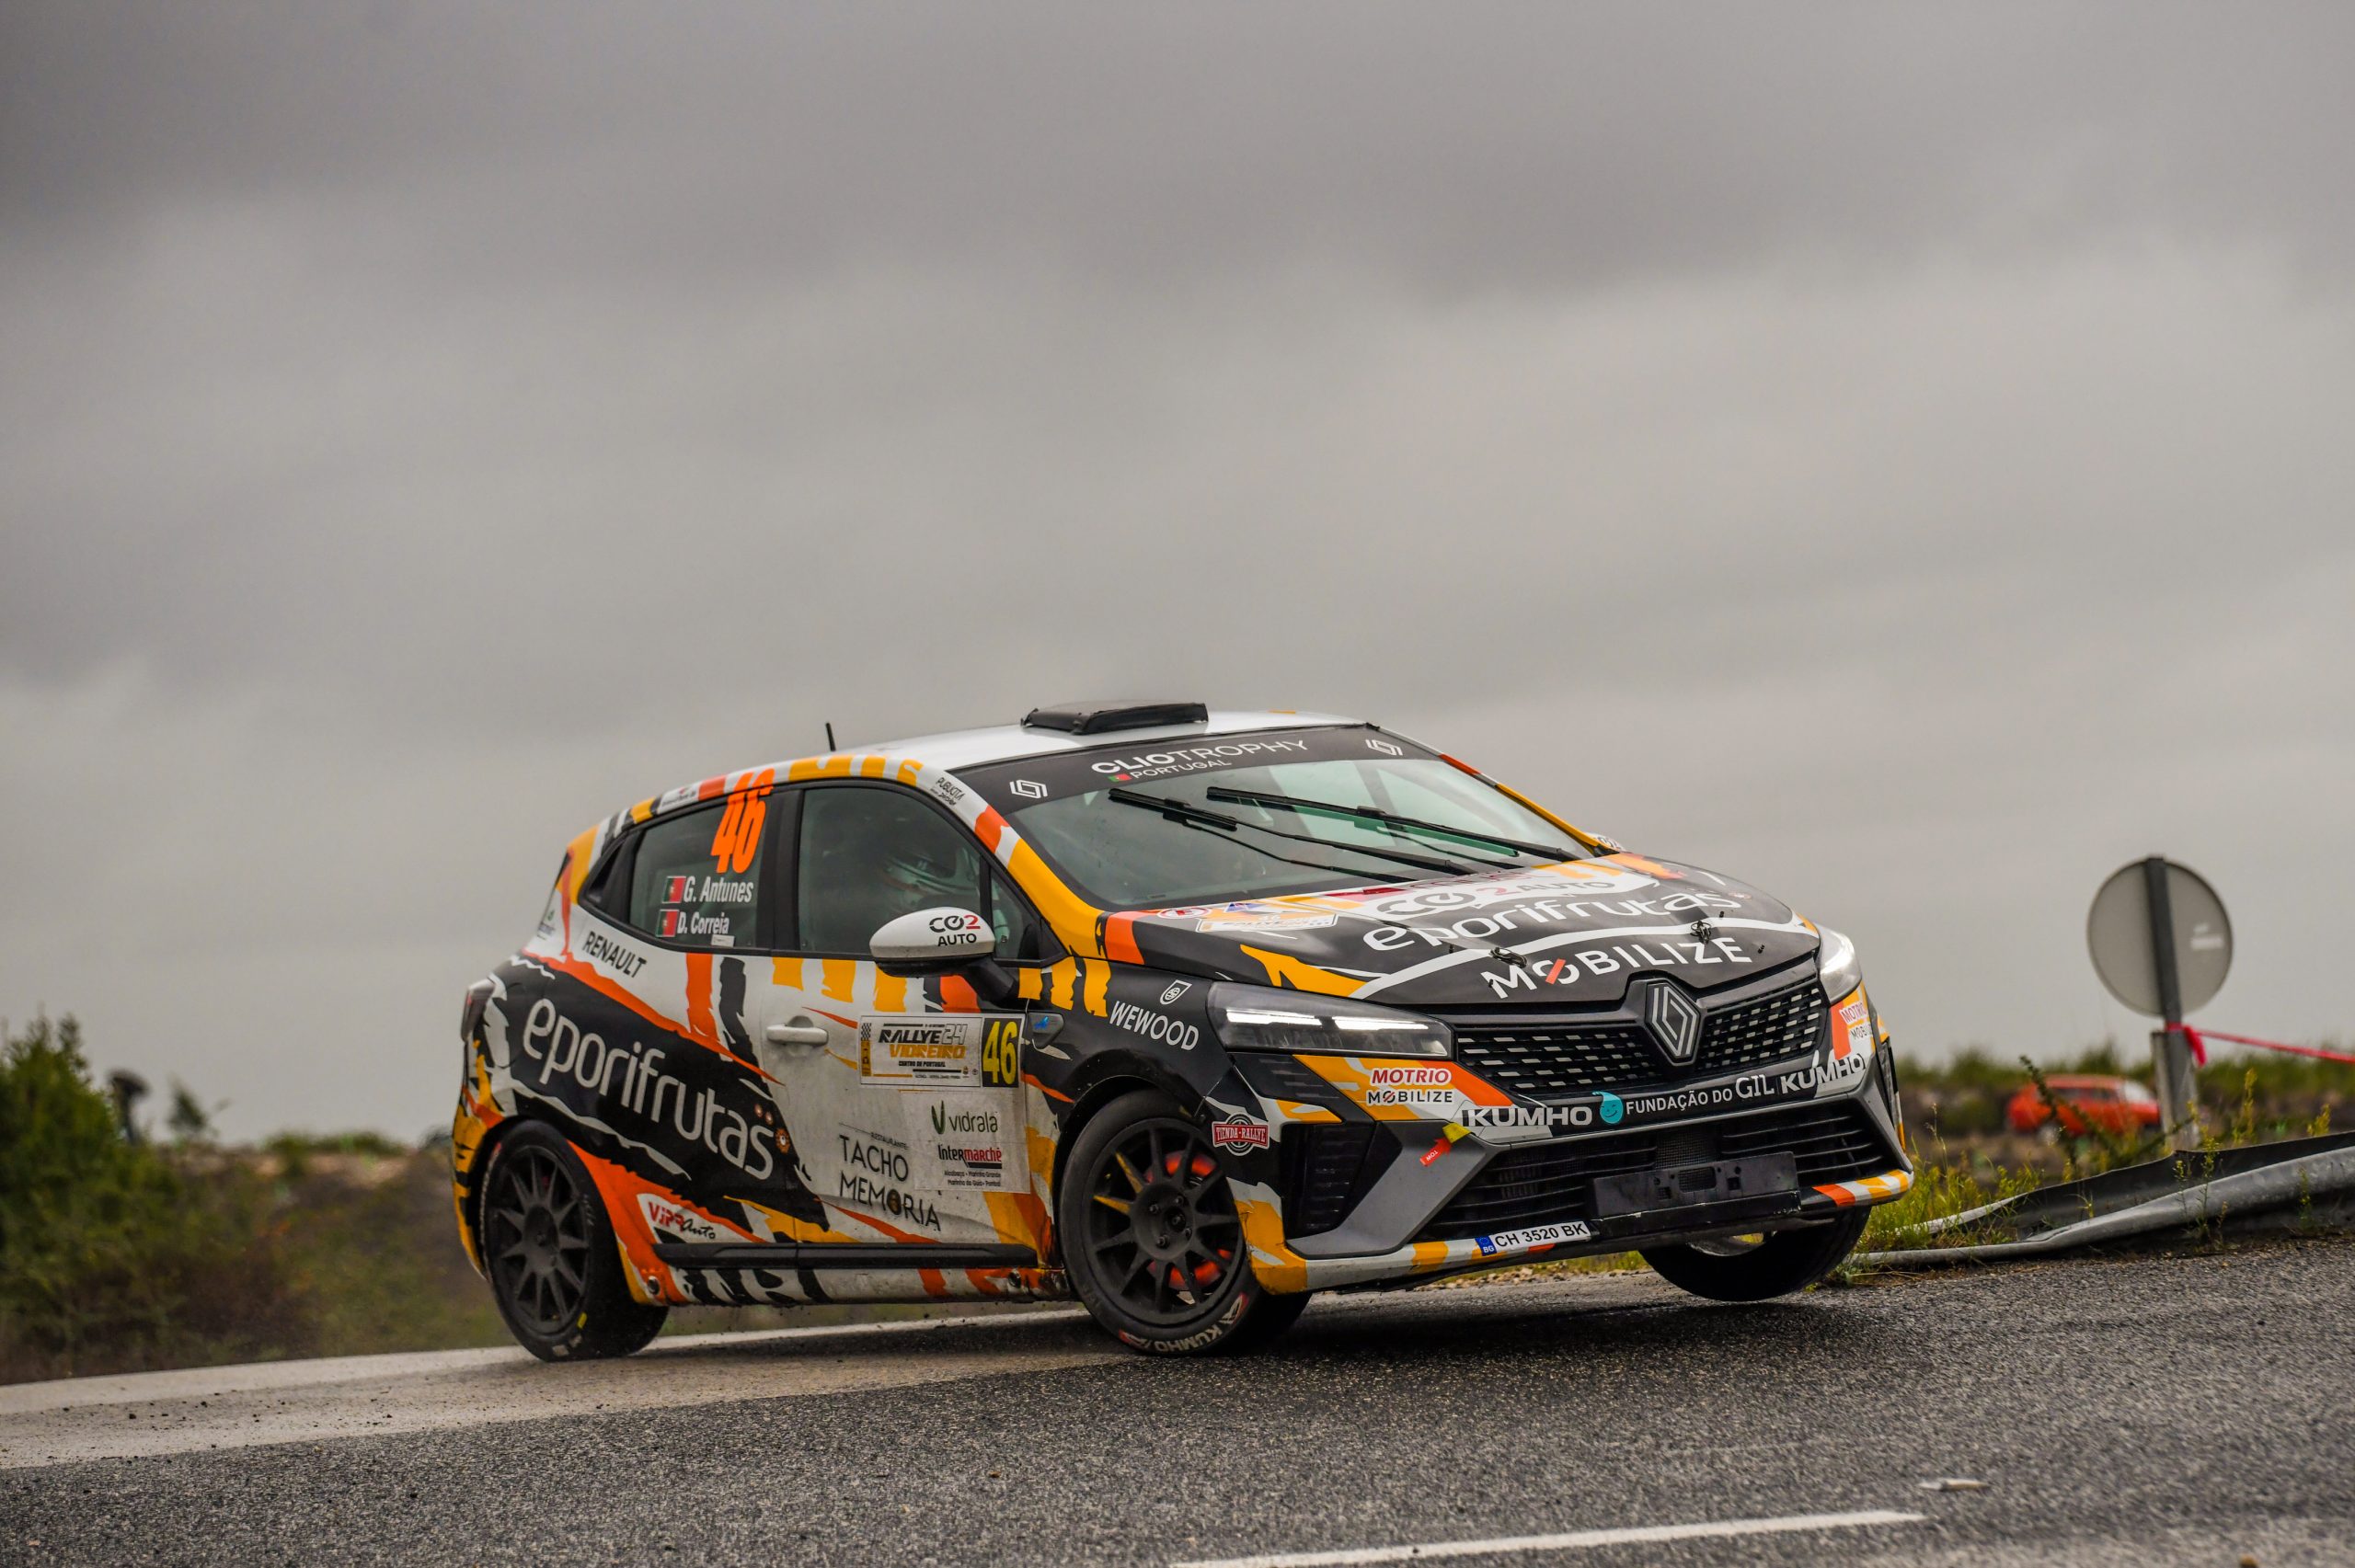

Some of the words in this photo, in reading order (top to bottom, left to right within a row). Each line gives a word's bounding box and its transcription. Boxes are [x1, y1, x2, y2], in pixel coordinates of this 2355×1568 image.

[1130, 759, 1233, 779] PORTUGAL
[710, 767, 775, 874] 46
[684, 876, 696, 903] G.
[699, 876, 753, 903] Antunes
[1515, 881, 1615, 892] AUTO
[677, 910, 687, 934] D.
[690, 911, 729, 934] Correia
[1363, 892, 1741, 951] eporifrutas
[938, 933, 977, 947] AUTO
[581, 931, 648, 979] RENAULT
[879, 1029, 942, 1044] RALLYE
[941, 1024, 968, 1045] 24
[1109, 1000, 1200, 1051] WEWOOD
[982, 1021, 1018, 1085] 46
[1372, 1069, 1450, 1085] MOTRIO
[1780, 1053, 1867, 1094] KUMHO
[523, 998, 775, 1181] eporifrutas
[1626, 1090, 1708, 1116] FUNDAÇÃO
[1712, 1088, 1733, 1104] DO
[1735, 1074, 1775, 1099] GIL
[948, 1111, 998, 1132] vidrala
[1463, 1106, 1592, 1127] KUMHO
[1215, 1127, 1238, 1140] TIENDA
[1241, 1127, 1266, 1142] RALLYE
[839, 1134, 909, 1182] TACHO
[1426, 1150, 1438, 1162] TOW
[839, 1171, 942, 1232] MEMORIA
[1482, 1245, 1495, 1253] BG
[1495, 1233, 1521, 1247] CH
[1522, 1227, 1559, 1242] 3520
[1561, 1222, 1588, 1237] BK
[1154, 1324, 1223, 1353] KUMHO
